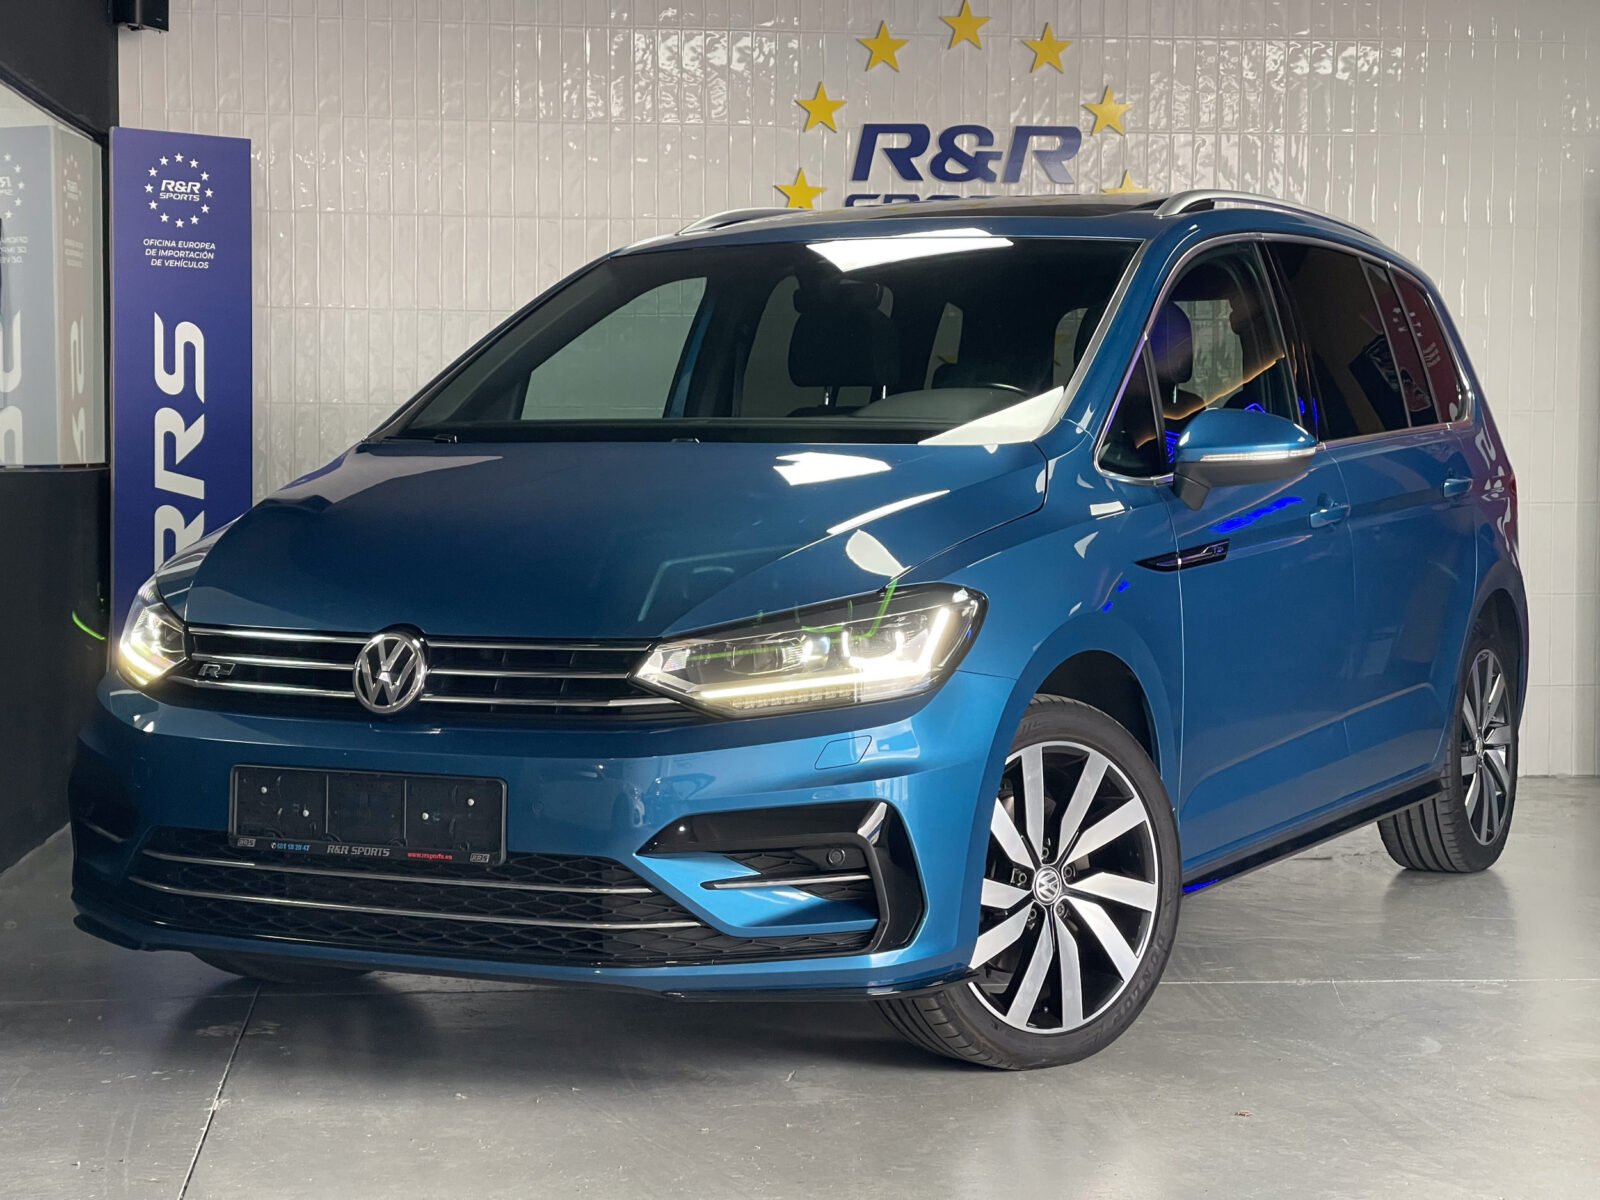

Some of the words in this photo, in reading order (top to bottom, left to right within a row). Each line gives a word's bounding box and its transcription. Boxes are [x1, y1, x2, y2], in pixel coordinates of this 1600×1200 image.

[852, 123, 1082, 184] R&R
[161, 179, 201, 194] R&R
[159, 192, 200, 202] SPORTS
[143, 238, 177, 248] OFICINA
[177, 240, 216, 250] EUROPEA
[145, 248, 157, 256] DE
[158, 249, 214, 260] IMPORTACIÓN
[150, 258, 162, 267] DE
[164, 258, 209, 269] VEHÍCULOS
[327, 844, 350, 855] R&R
[350, 846, 391, 857] SPORTS
